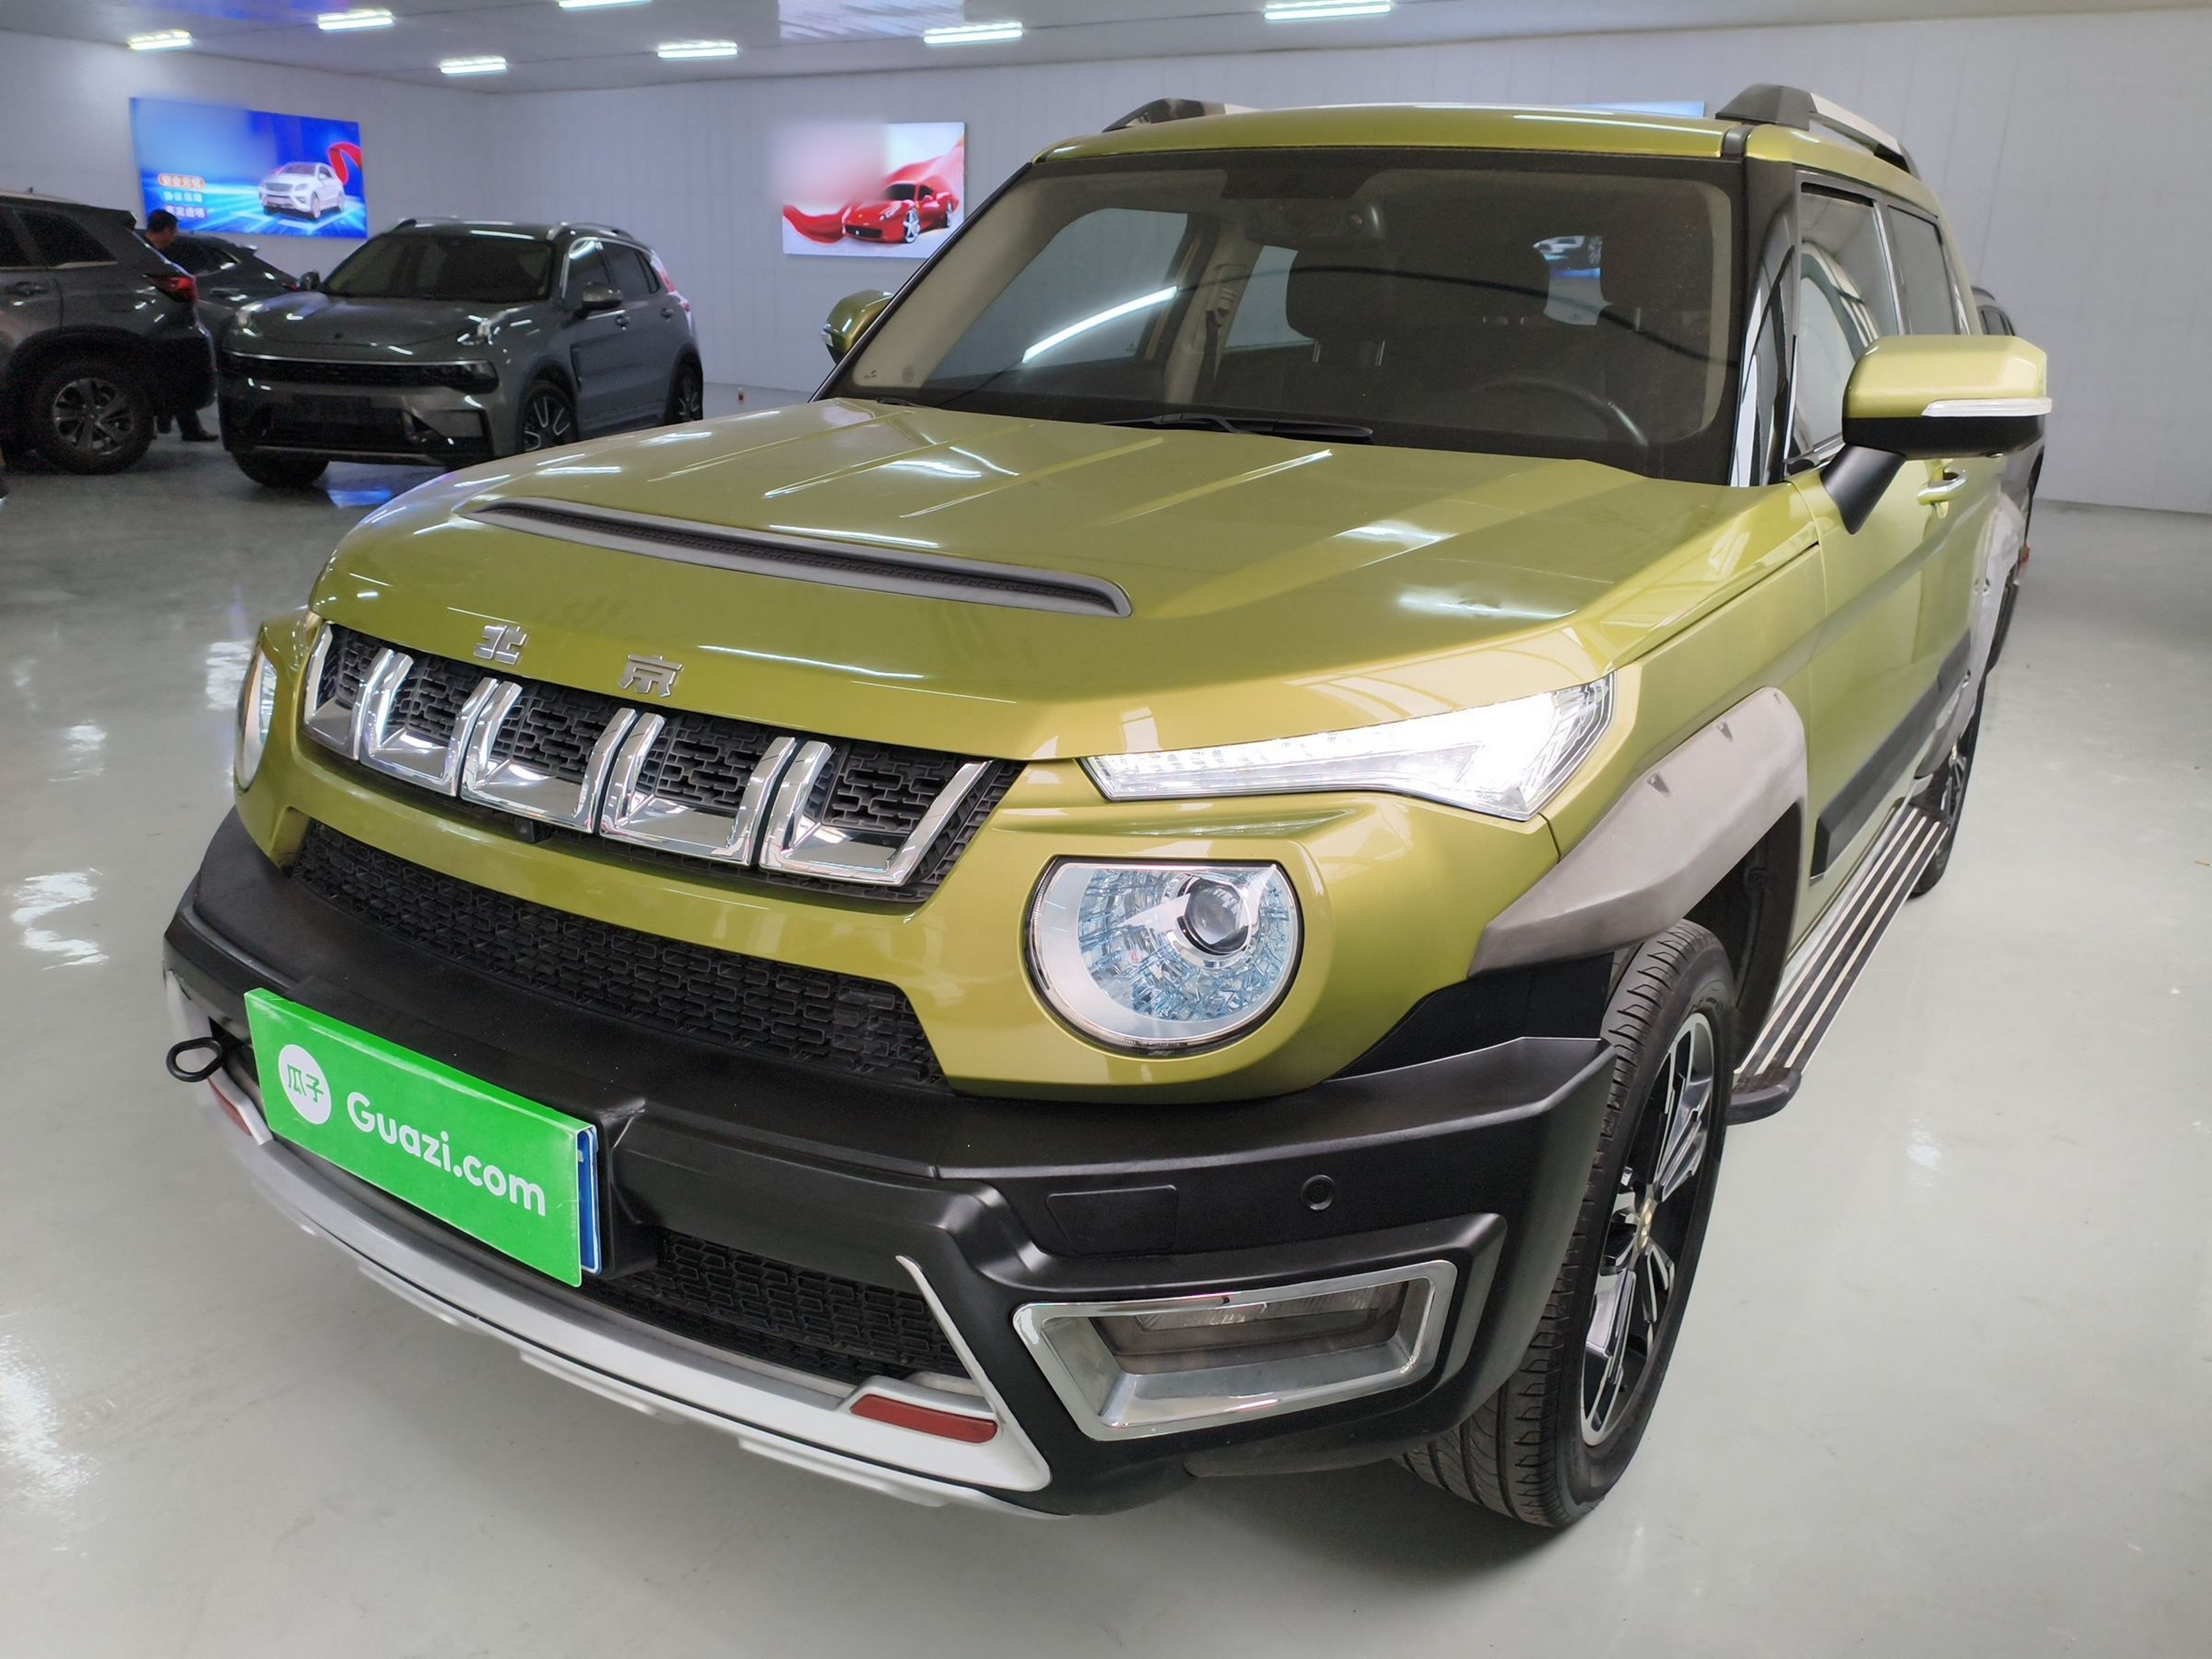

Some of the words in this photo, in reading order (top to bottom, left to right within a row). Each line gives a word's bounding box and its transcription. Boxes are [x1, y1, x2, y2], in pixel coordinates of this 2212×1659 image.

[474, 625, 683, 698] 北京
[287, 1063, 324, 1103] 瓜子
[347, 1092, 546, 1216] Guazi.com
